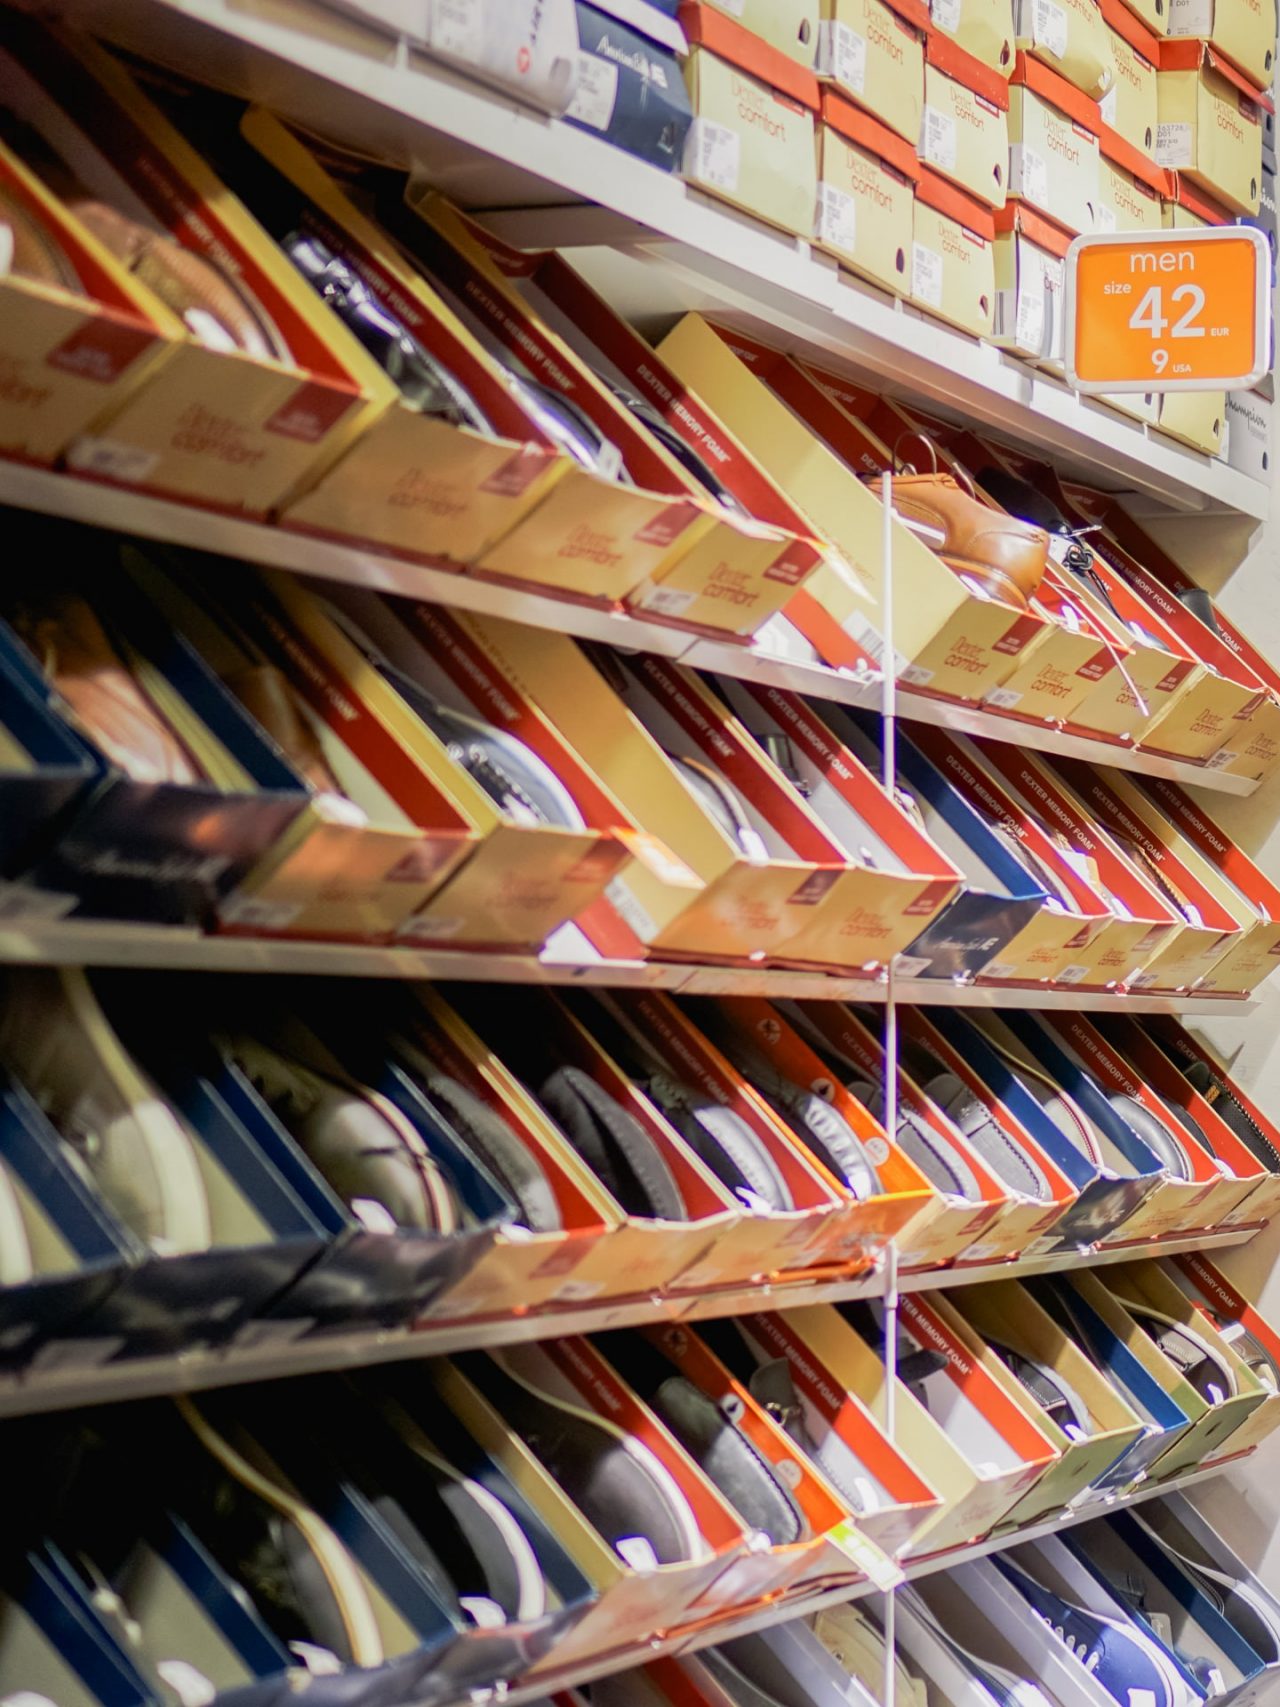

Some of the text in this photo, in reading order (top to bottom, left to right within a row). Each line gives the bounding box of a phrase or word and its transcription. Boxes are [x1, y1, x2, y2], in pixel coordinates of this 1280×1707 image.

[1130, 251, 1195, 272] men
[1104, 281, 1229, 339] size 42 EUR
[1152, 349, 1191, 374] 9 USA
[636, 363, 673, 402] DEXTER
[669, 398, 705, 439] MEMORY
[1097, 543, 1126, 571] DEXTER
[1124, 565, 1154, 597] MEMORY
[767, 688, 801, 723] DEXTER
[798, 719, 831, 756] MEMORY
[946, 755, 976, 787] DEXTER
[974, 783, 1008, 817] MEMORY
[1021, 770, 1048, 799] DEXTER
[1045, 796, 1076, 829] MEMORY
[1092, 786, 1119, 814] DEXTER
[1117, 810, 1146, 842] MEMORY
[1155, 781, 1181, 809] DEXTER
[1179, 804, 1208, 836] MEMORY
[1071, 1023, 1099, 1057] DEXTER
[1096, 1051, 1127, 1087] MEMORY
